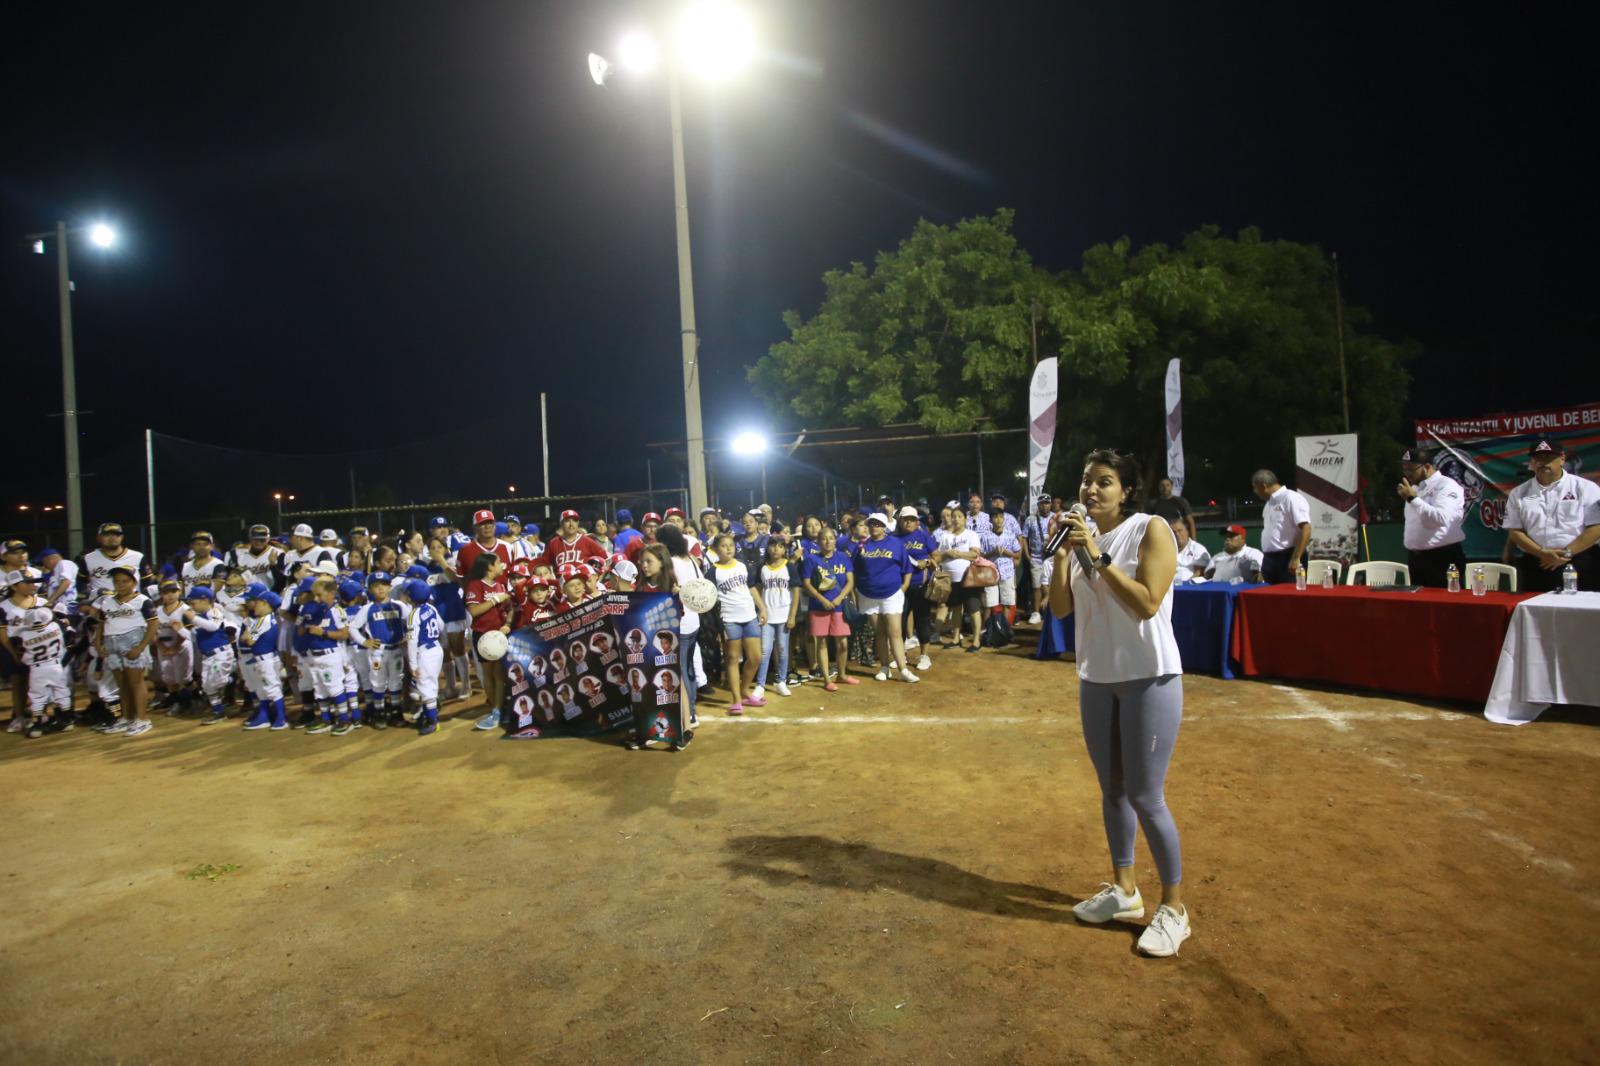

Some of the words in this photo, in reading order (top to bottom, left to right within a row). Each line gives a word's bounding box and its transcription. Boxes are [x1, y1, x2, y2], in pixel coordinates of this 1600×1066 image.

[1504, 418, 1512, 430] Y
[1513, 415, 1560, 433] JUVENIL
[1562, 411, 1579, 425] DE
[1309, 457, 1344, 465] IMDEM
[555, 550, 585, 566] GDL
